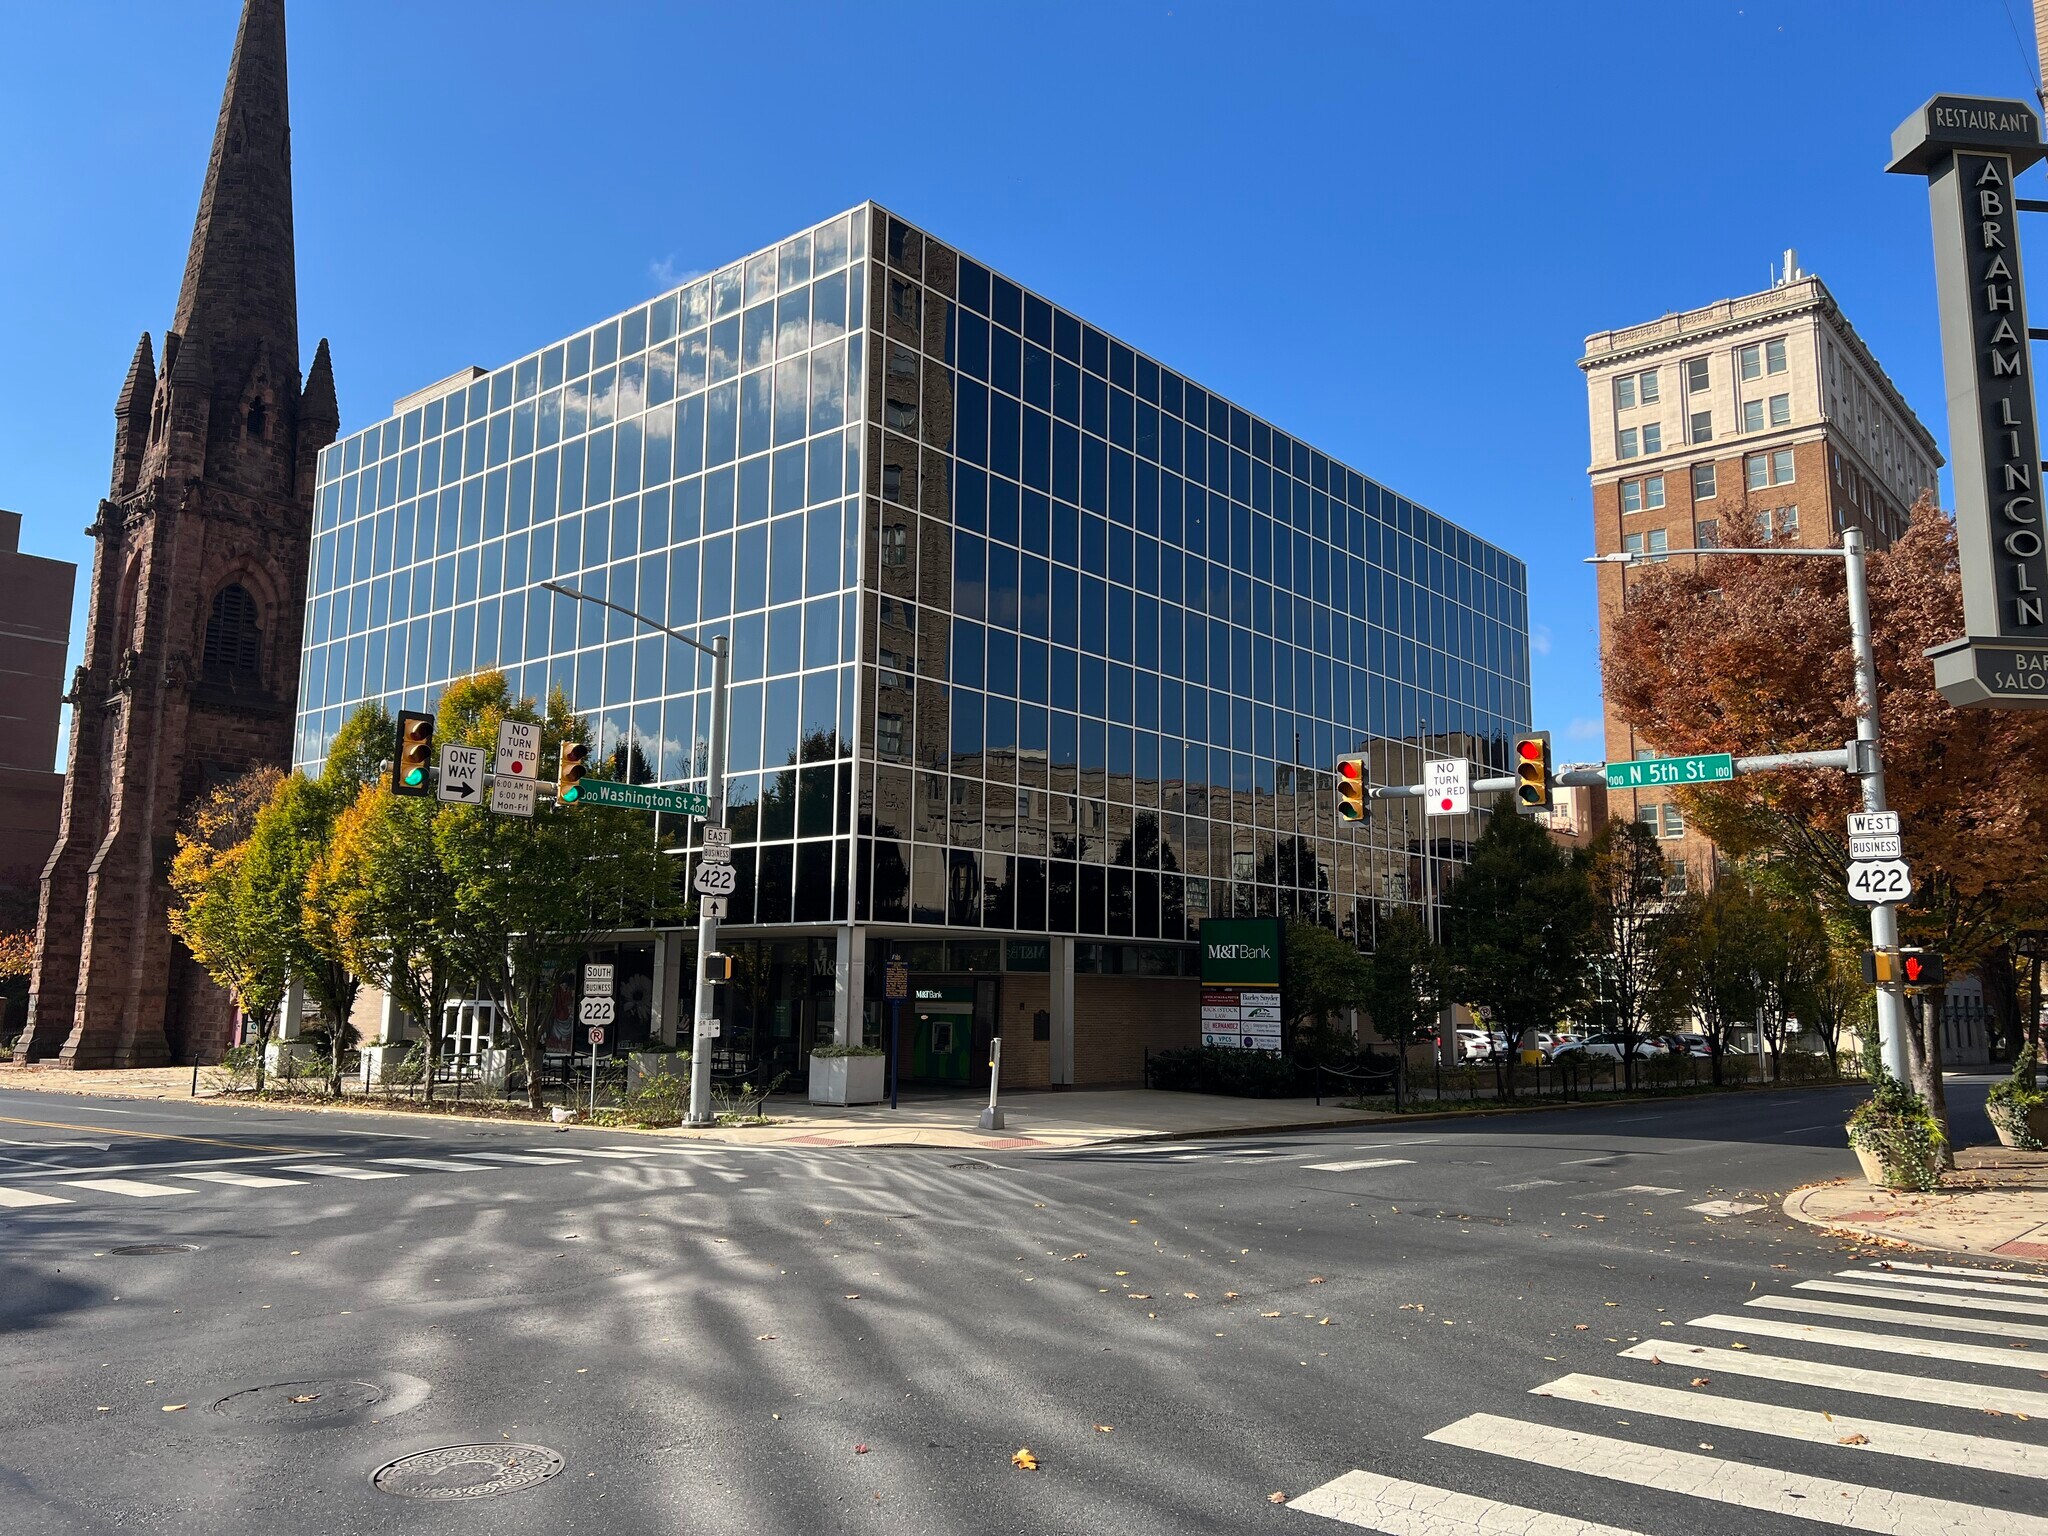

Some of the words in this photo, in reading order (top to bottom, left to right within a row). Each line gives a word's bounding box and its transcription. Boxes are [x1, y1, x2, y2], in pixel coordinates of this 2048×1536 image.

[1935, 107, 2029, 133] RESTAURANT
[1976, 160, 2022, 377] ABRAHAM
[2002, 397, 2044, 626] LINCOLN
[1995, 671, 2048, 690] SALO
[511, 724, 529, 736] NO
[507, 736, 532, 749] TURN
[449, 750, 477, 765] ONE
[500, 747, 513, 758] ON
[518, 750, 536, 761] RED
[448, 764, 477, 779] WAY
[1436, 762, 1455, 774] NO
[1629, 765, 1642, 784] N
[1649, 762, 1679, 783] 5th
[1685, 760, 1706, 780] St
[1715, 766, 1729, 778] 100
[496, 779, 512, 788] 6:00
[513, 782, 524, 790] AM
[525, 783, 533, 791] to
[1433, 775, 1459, 785] TURN
[1608, 775, 1624, 786] 000
[499, 790, 516, 800] 6:00
[518, 793, 529, 801] PM
[600, 786, 672, 809] Washington
[675, 796, 688, 810] St
[1427, 788, 1441, 797] ON
[1446, 786, 1466, 796] RED
[497, 801, 529, 812] Mon-Fri
[689, 804, 705, 814] 400
[1854, 816, 1892, 831] WEST
[707, 829, 728, 842] EAST
[704, 848, 729, 859] BUSINESS
[1853, 841, 1897, 853] BUSINESS
[699, 869, 731, 889] 422
[1855, 868, 1904, 893] 422
[1208, 944, 1239, 959] M&T
[1240, 944, 1271, 959] Bank
[587, 966, 612, 977] SOUTH
[586, 983, 611, 992] BUSINESS
[583, 1003, 611, 1020] 222
